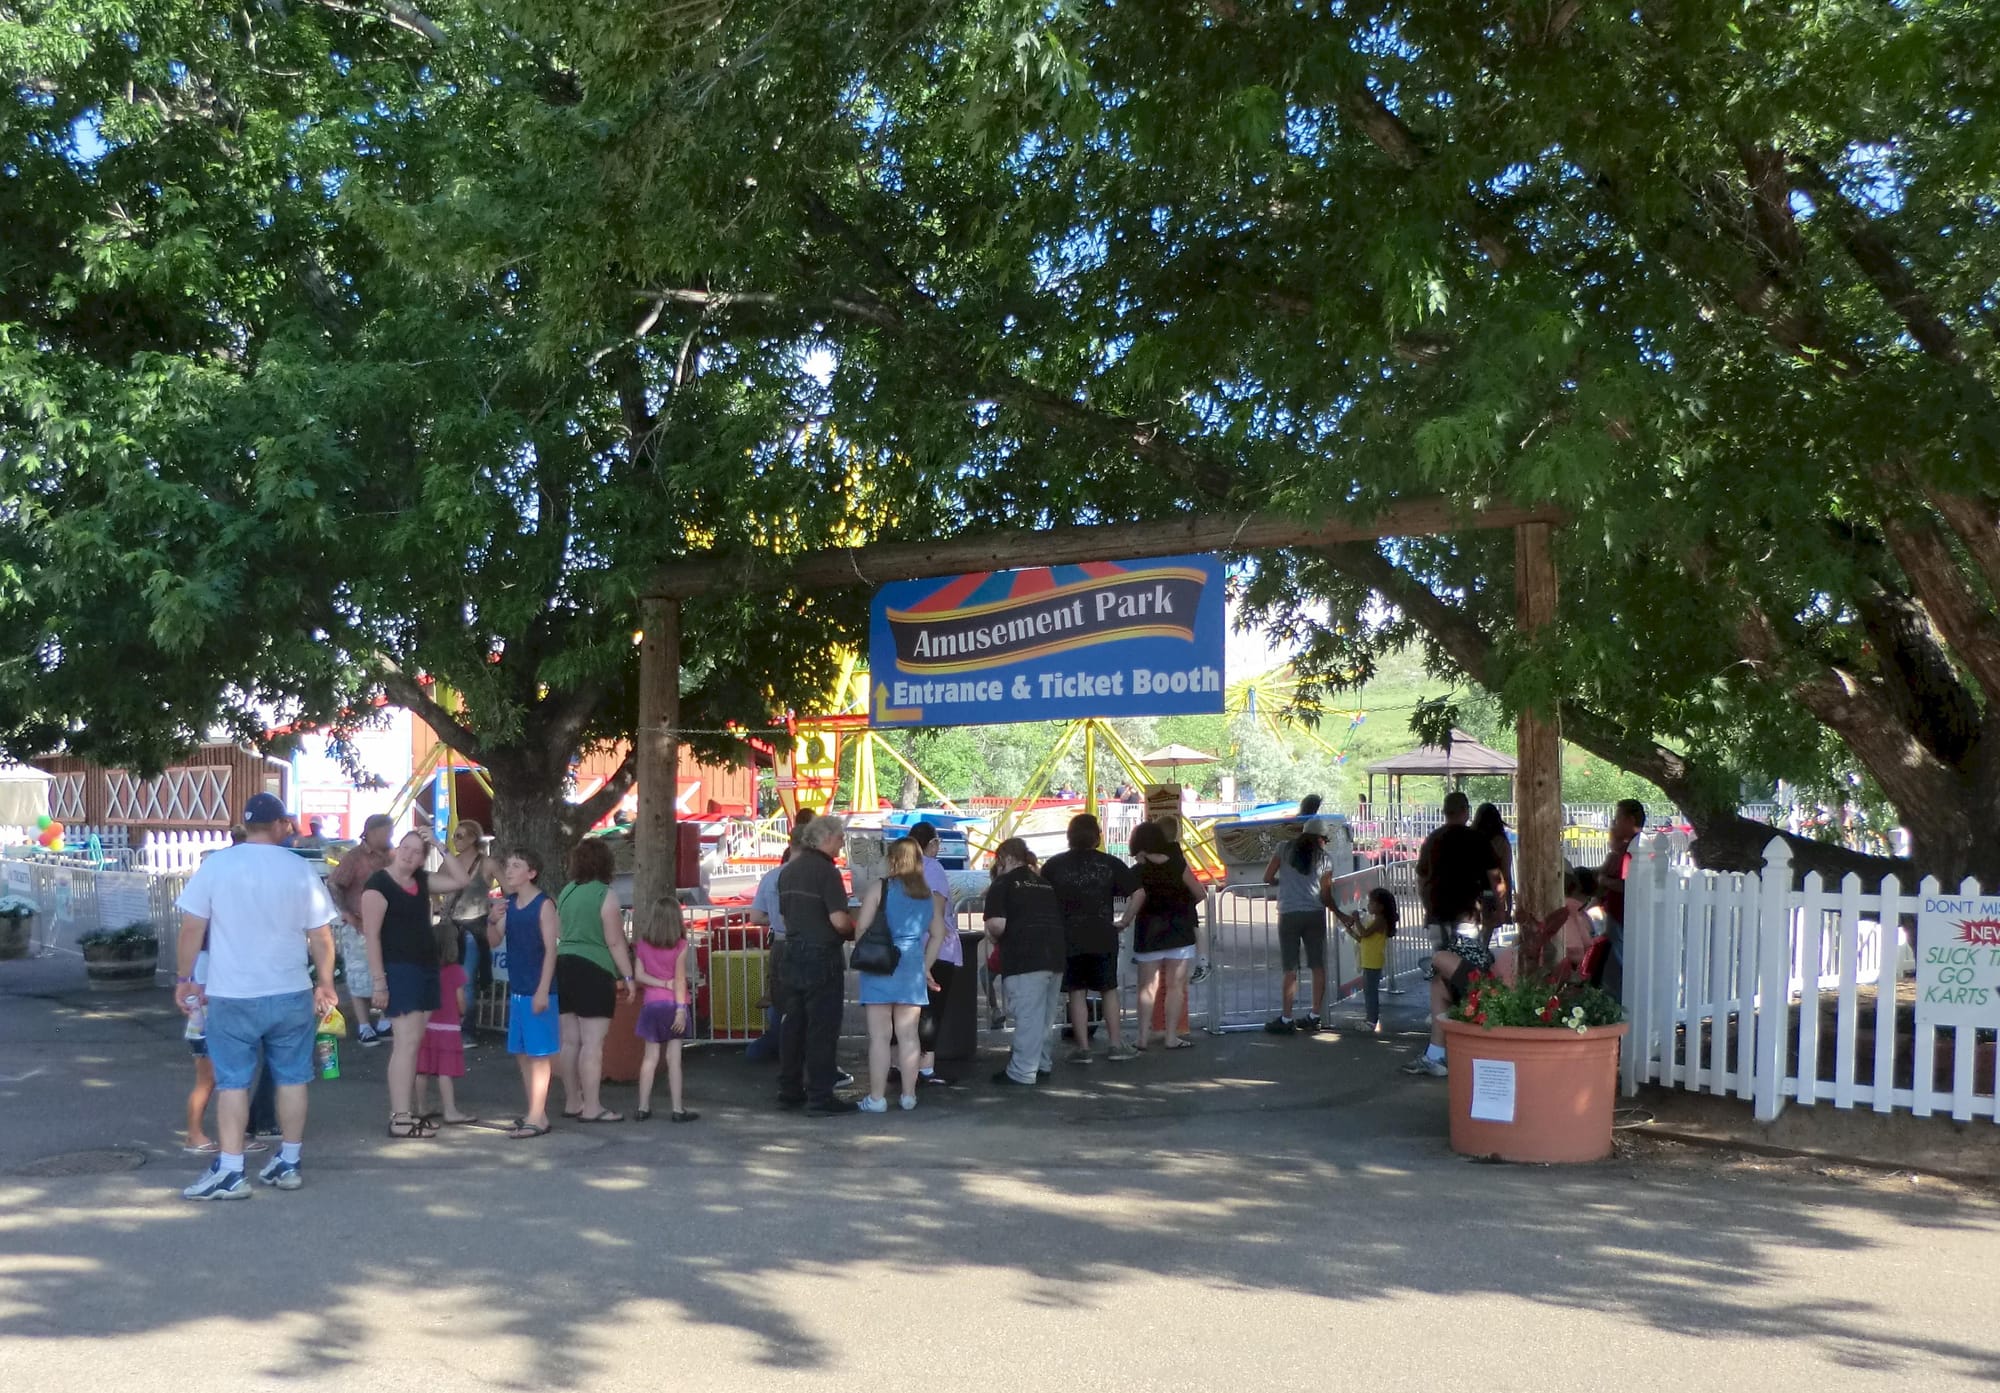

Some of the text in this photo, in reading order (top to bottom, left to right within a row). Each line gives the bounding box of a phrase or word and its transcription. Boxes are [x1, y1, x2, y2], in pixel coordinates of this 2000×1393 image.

[913, 585, 1173, 658] Amusement Park
[893, 665, 1220, 705] Entrance & Ticket Booth
[1925, 899, 2000, 915] DON'T MI
[1925, 946, 1981, 966] SLICK
[1938, 966, 1975, 985] GO
[1924, 985, 1989, 1006] KARTS
